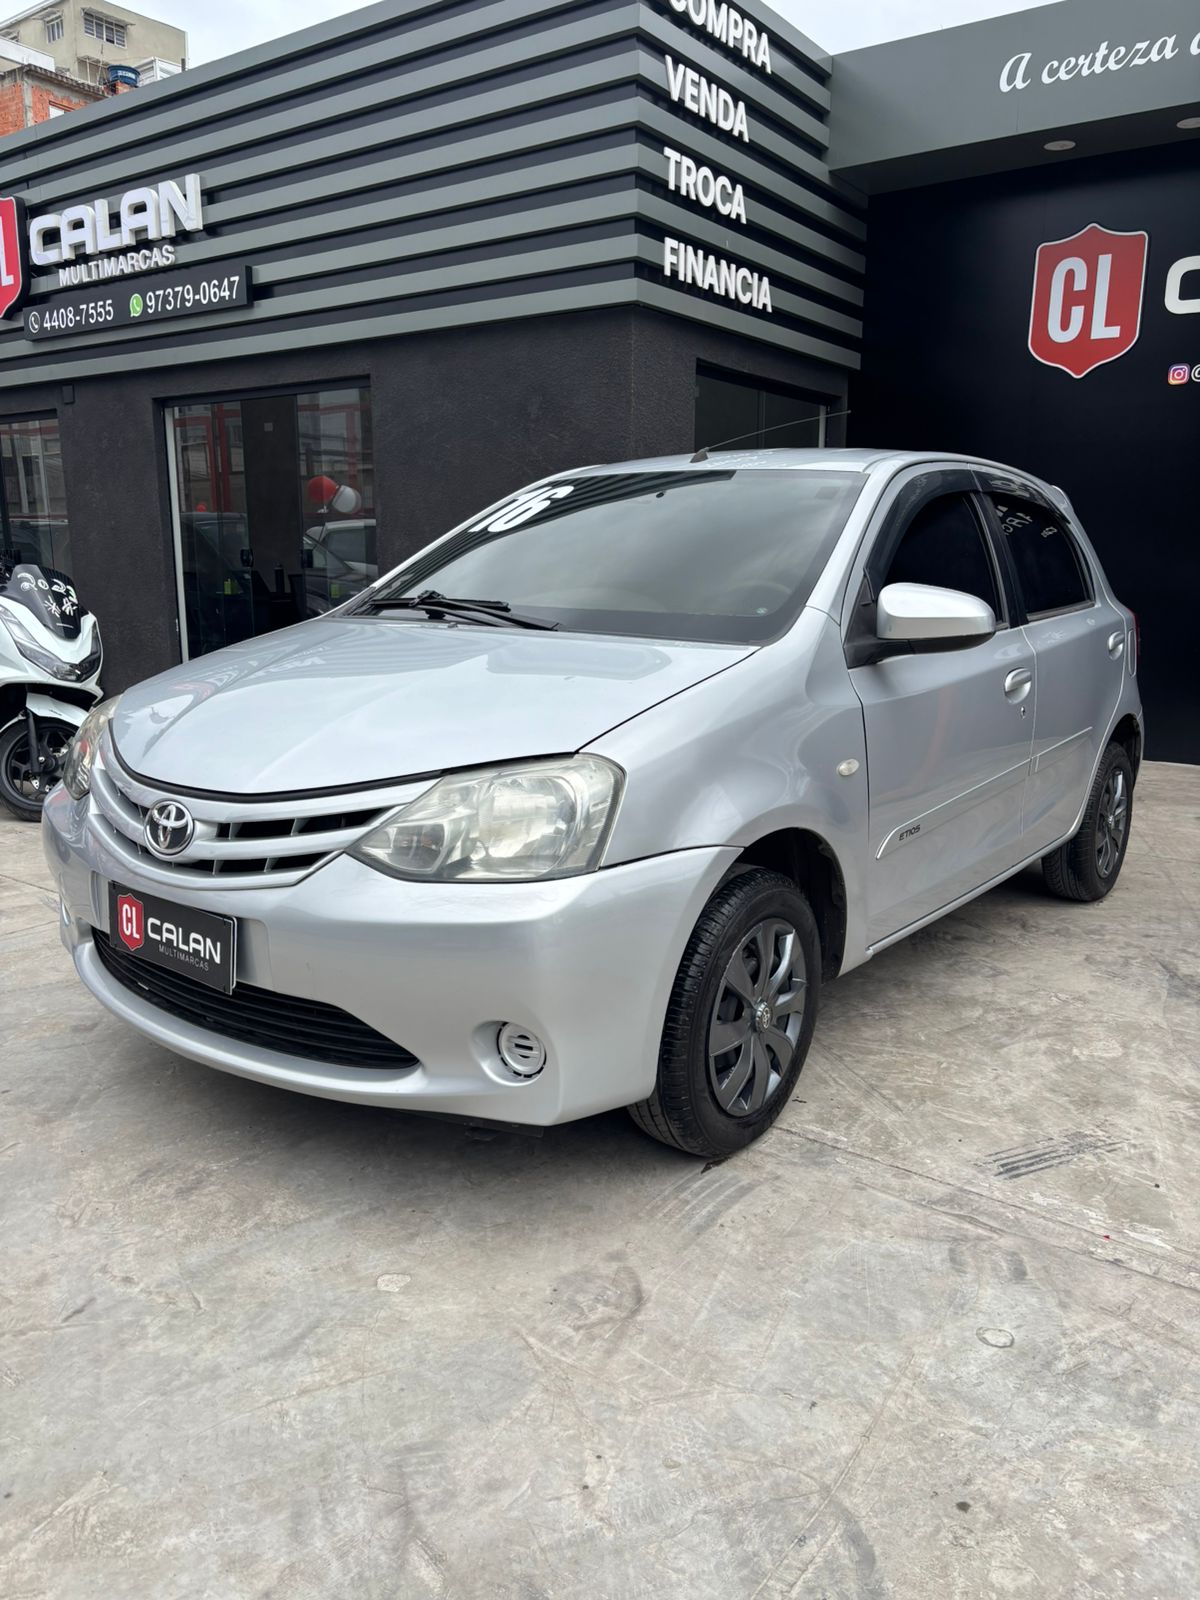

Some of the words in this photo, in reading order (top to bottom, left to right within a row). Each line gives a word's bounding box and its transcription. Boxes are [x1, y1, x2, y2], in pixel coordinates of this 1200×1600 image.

[669, 0, 772, 74] OMPRA
[999, 52, 1032, 93] A
[1041, 34, 1179, 84] certeza
[665, 54, 749, 143] VENDA
[663, 146, 747, 225] TROCA
[29, 173, 203, 266] CALAN
[58, 245, 176, 287] MULTIMARCAS
[664, 236, 772, 313] FINANCIA
[43, 299, 115, 331] 4408-7555
[146, 276, 240, 314] 97379-0647
[1047, 253, 1121, 344] CL
[898, 824, 921, 841] ETIOS
[122, 903, 141, 940] CL
[147, 917, 221, 965] CALAN
[158, 944, 209, 972] MULTIMARCAS
